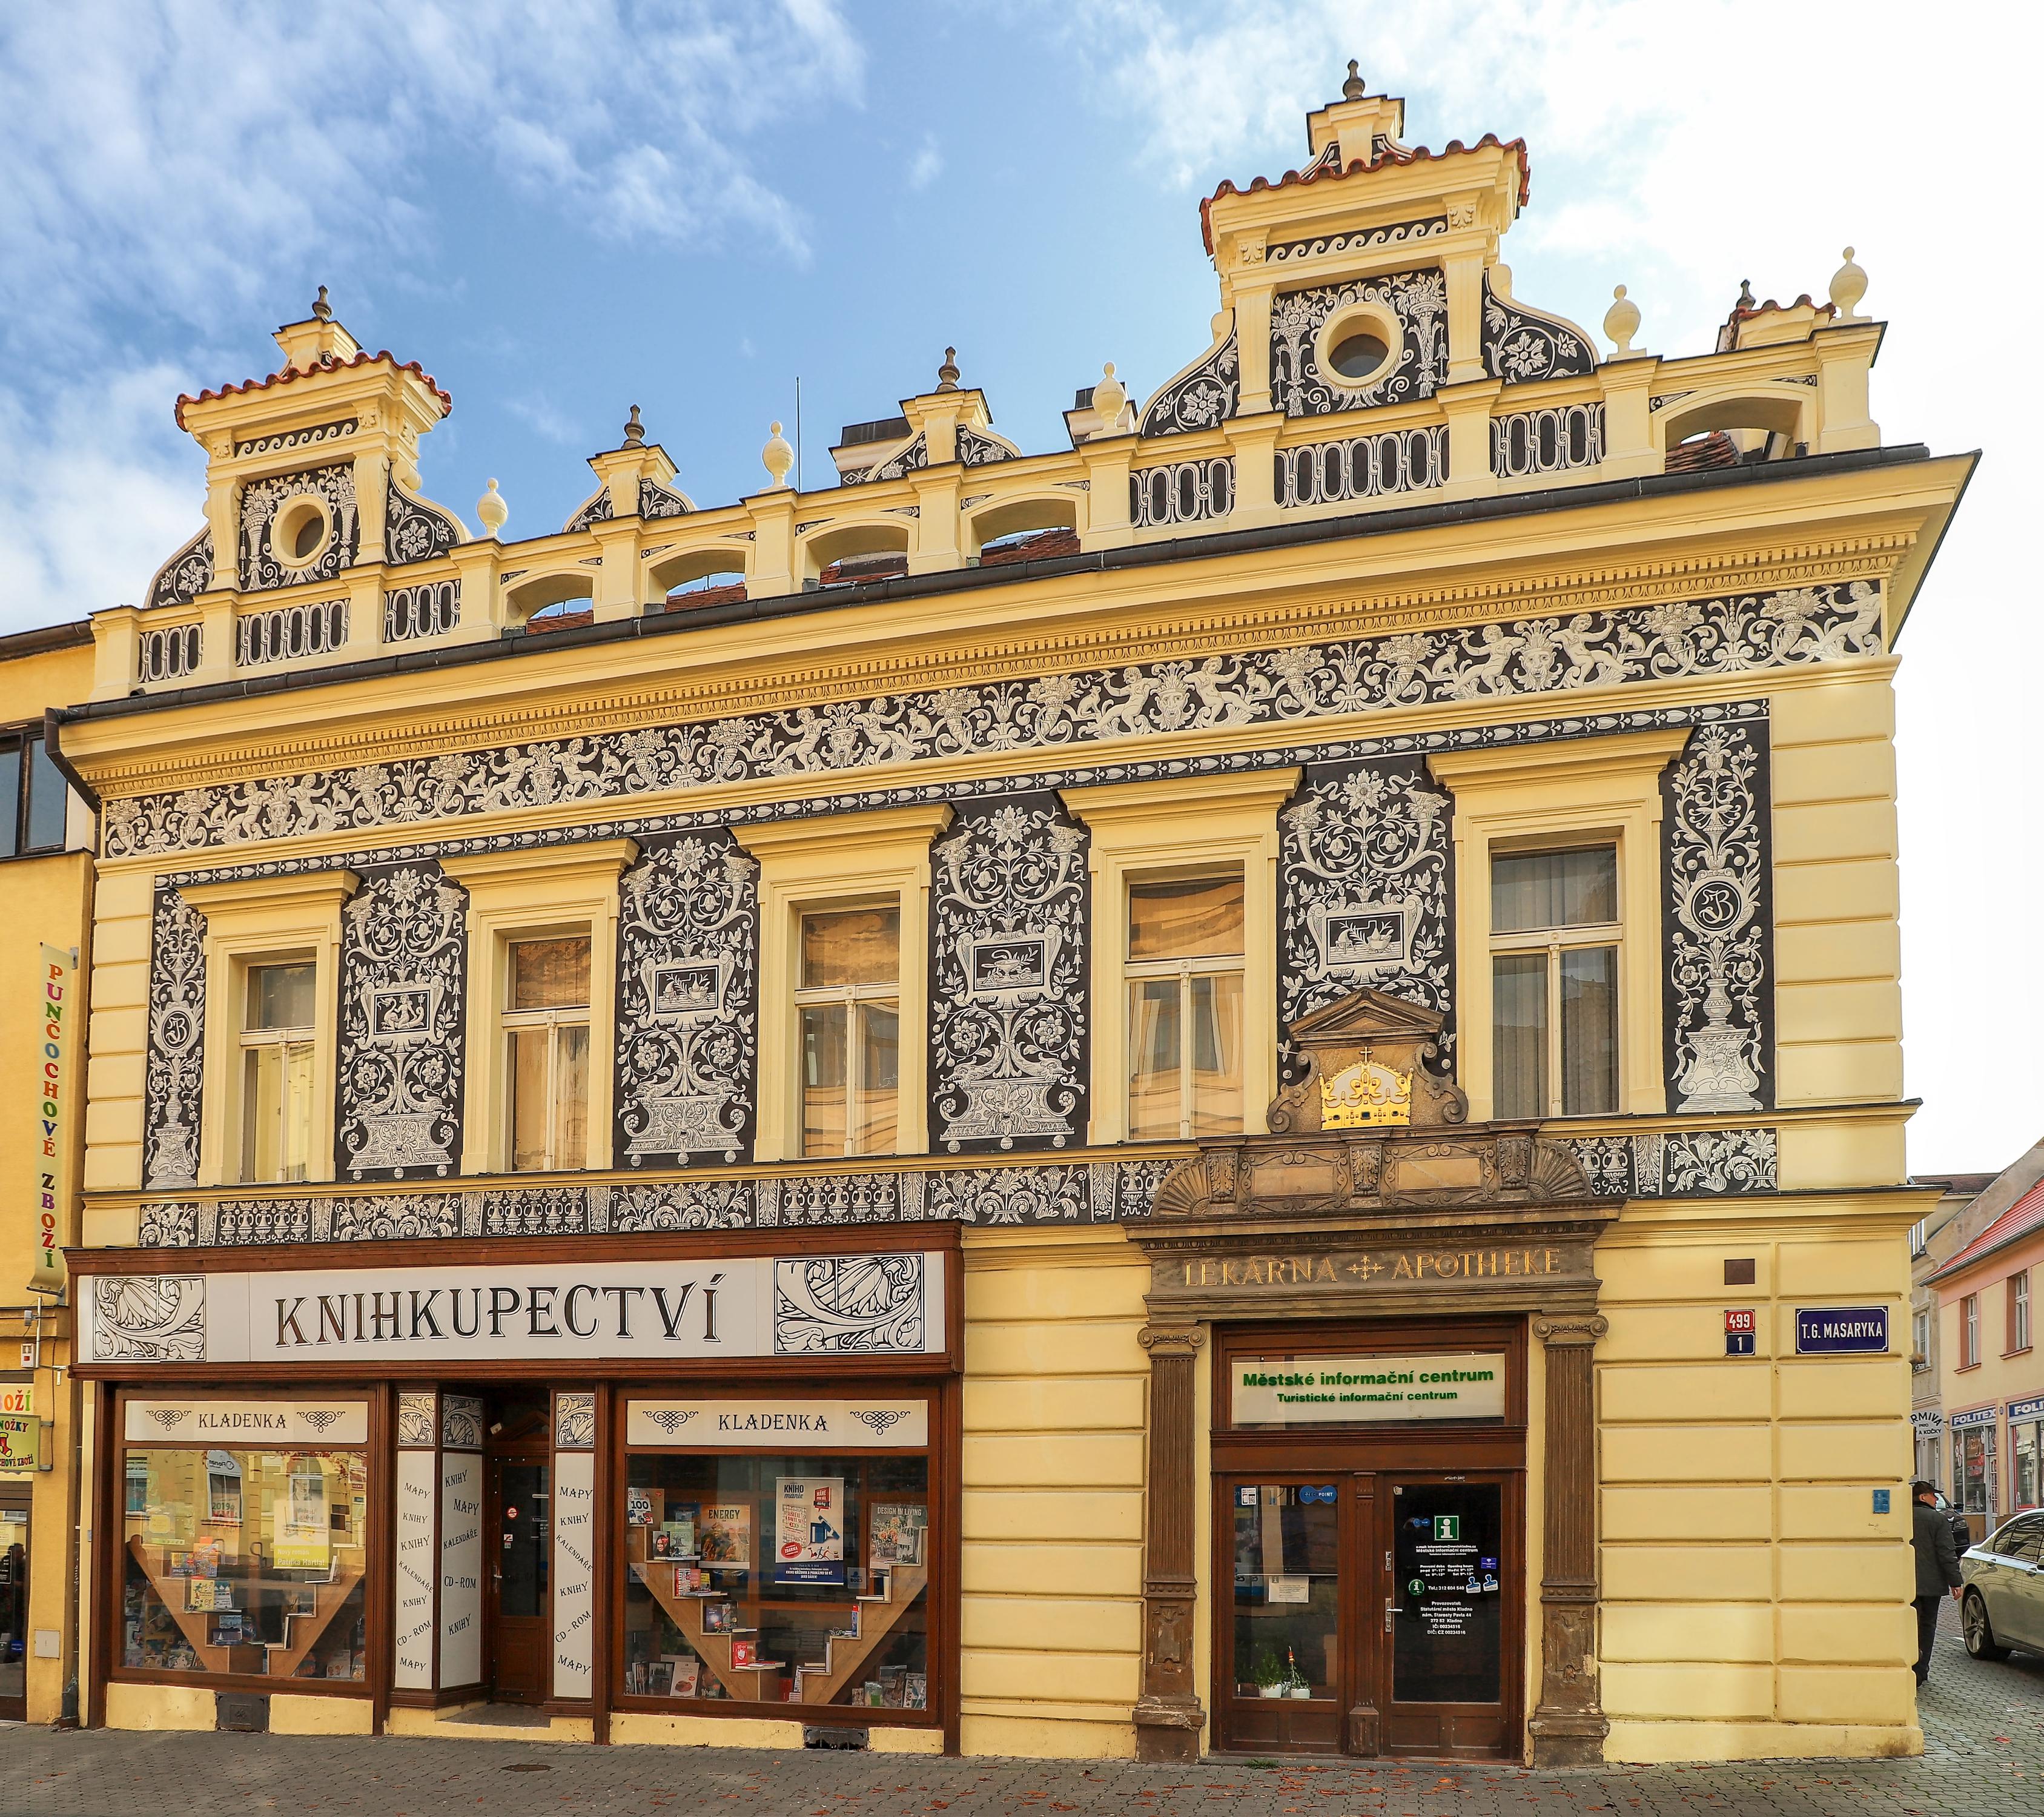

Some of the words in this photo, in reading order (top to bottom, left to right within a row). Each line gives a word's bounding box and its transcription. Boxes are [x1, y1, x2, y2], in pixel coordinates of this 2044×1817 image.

[41, 963, 63, 1157] PUNČOCHOVÉ
[41, 1173, 56, 1268] ZBOŽÍ
[1392, 1248, 1561, 1280] APOTHEKE
[274, 1273, 727, 1348] KNIHKUPECTVÍ
[1728, 1314, 1750, 1328] 499
[1824, 1322, 1883, 1338] MASARYKA
[1737, 1337, 1743, 1351] 1
[1243, 1371, 1315, 1387] Městské
[1320, 1370, 1414, 1385] informační
[1419, 1369, 1494, 1383] centrum
[0, 1389, 30, 1411] OŽÍ
[1277, 1392, 1336, 1403] Turistické
[1339, 1391, 1404, 1402] informační
[1407, 1390, 1458, 1400] centrum
[2014, 1400, 2044, 1415] FOLI
[198, 1413, 288, 1429] KLADENKA
[718, 1413, 829, 1432] KLADENKA
[1910, 1412, 1942, 1426] RMIVA
[1953, 1409, 1996, 1425] FOLITEX
[17, 1454, 34, 1466] ZBOŽÍ
[445, 1469, 467, 1488] KNIHY
[404, 1482, 431, 1499] MAPY
[560, 1486, 593, 1500] MAPY
[454, 1498, 480, 1515] MAPY
[631, 1501, 649, 1509] 100
[403, 1512, 428, 1524] KNIHY
[560, 1512, 589, 1526] KNIHY
[709, 1509, 739, 1519] ENERGY
[401, 1535, 430, 1551] KNIHY
[443, 1529, 478, 1550] KALENDÁŘE
[556, 1534, 592, 1572] KALENDÁŘE
[399, 1560, 434, 1594] KALENDÁŘE
[560, 1581, 589, 1597] KNIHY
[403, 1595, 427, 1607] KNIHY
[448, 1613, 471, 1635] KNIHY
[400, 1657, 426, 1671] MAPY
[557, 1654, 591, 1676] MAPY
